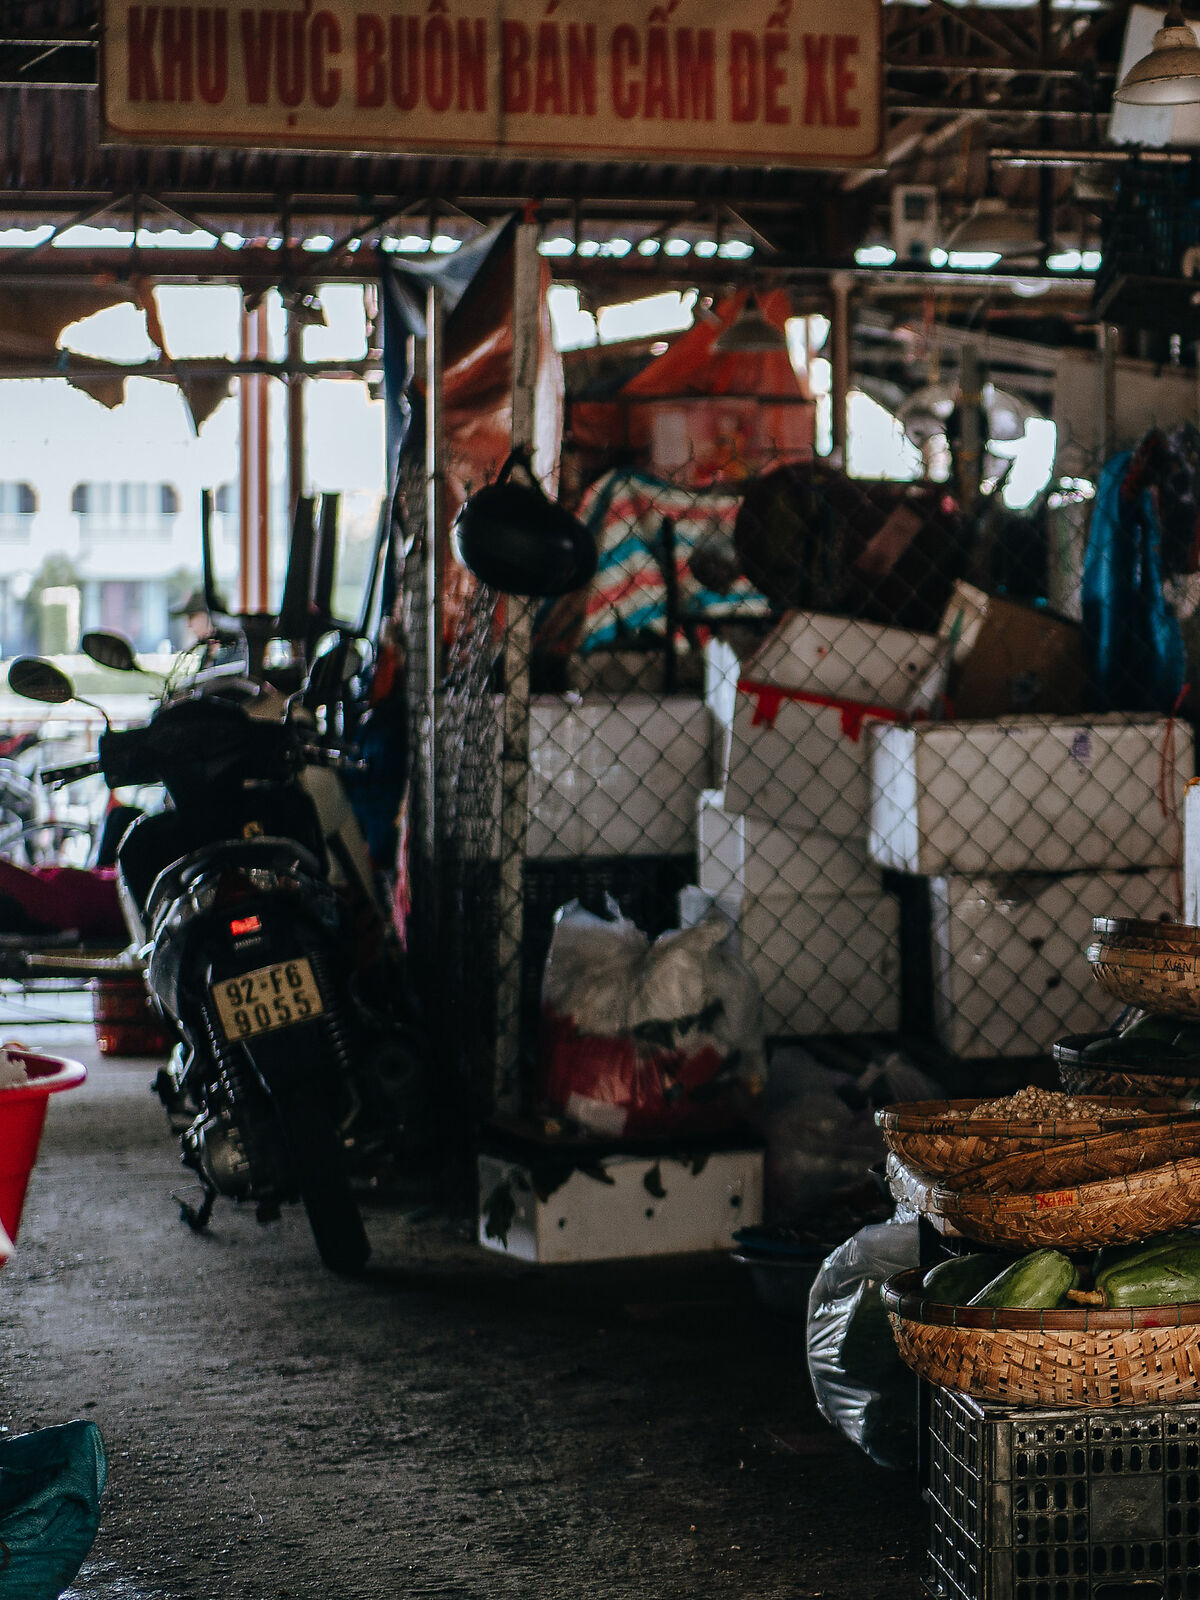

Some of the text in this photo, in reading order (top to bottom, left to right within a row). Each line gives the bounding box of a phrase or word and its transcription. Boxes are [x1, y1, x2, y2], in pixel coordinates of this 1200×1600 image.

[127, 0, 861, 128] KHU VỰC BUÔN BÁN CẤM ĐỂ XE
[225, 963, 303, 1007] 92-F6
[234, 989, 312, 1034] 9055
